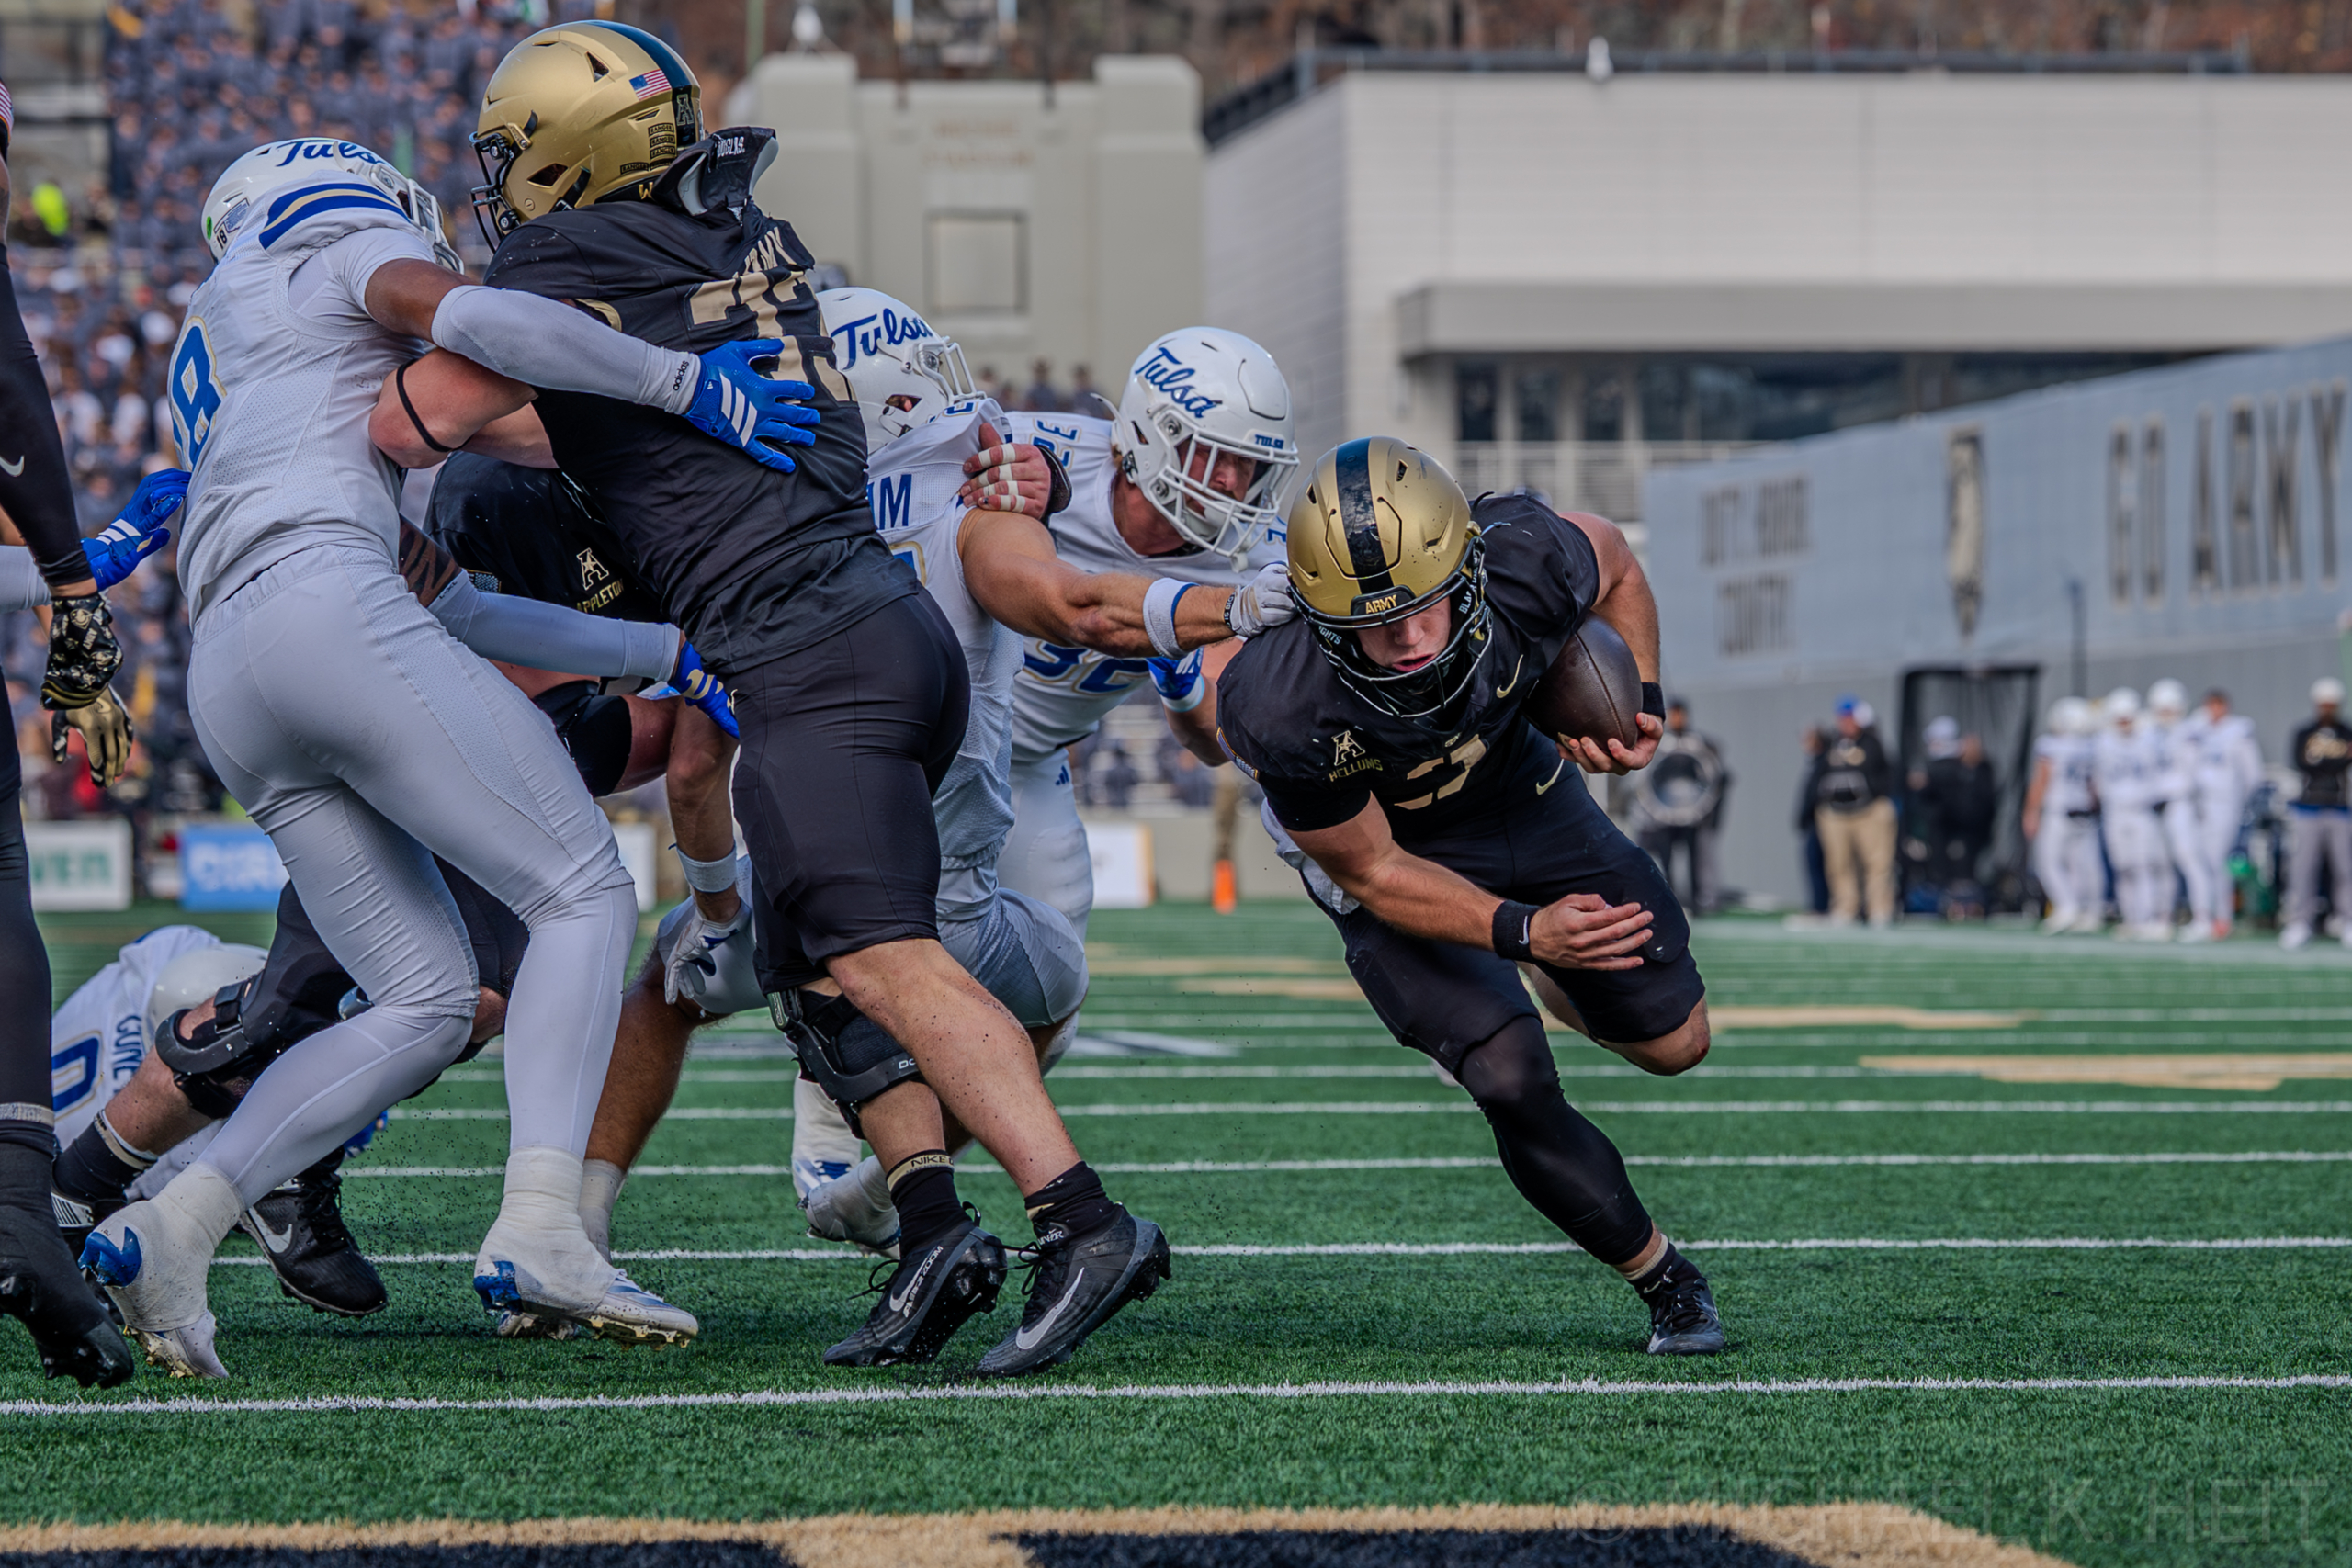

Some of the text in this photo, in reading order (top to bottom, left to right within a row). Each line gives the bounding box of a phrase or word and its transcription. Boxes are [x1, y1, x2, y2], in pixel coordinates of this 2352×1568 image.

[216, 229, 228, 249] 18
[673, 360, 689, 391] adidas
[1135, 346, 1223, 419] Tulsa
[167, 315, 227, 473] 8
[2188, 375, 2349, 607] ARMY
[1365, 594, 1397, 615] ARMY
[1329, 759, 1383, 783] HELLUMS
[910, 1156, 946, 1168] NIKE
[921, 1245, 944, 1277] ZOOM
